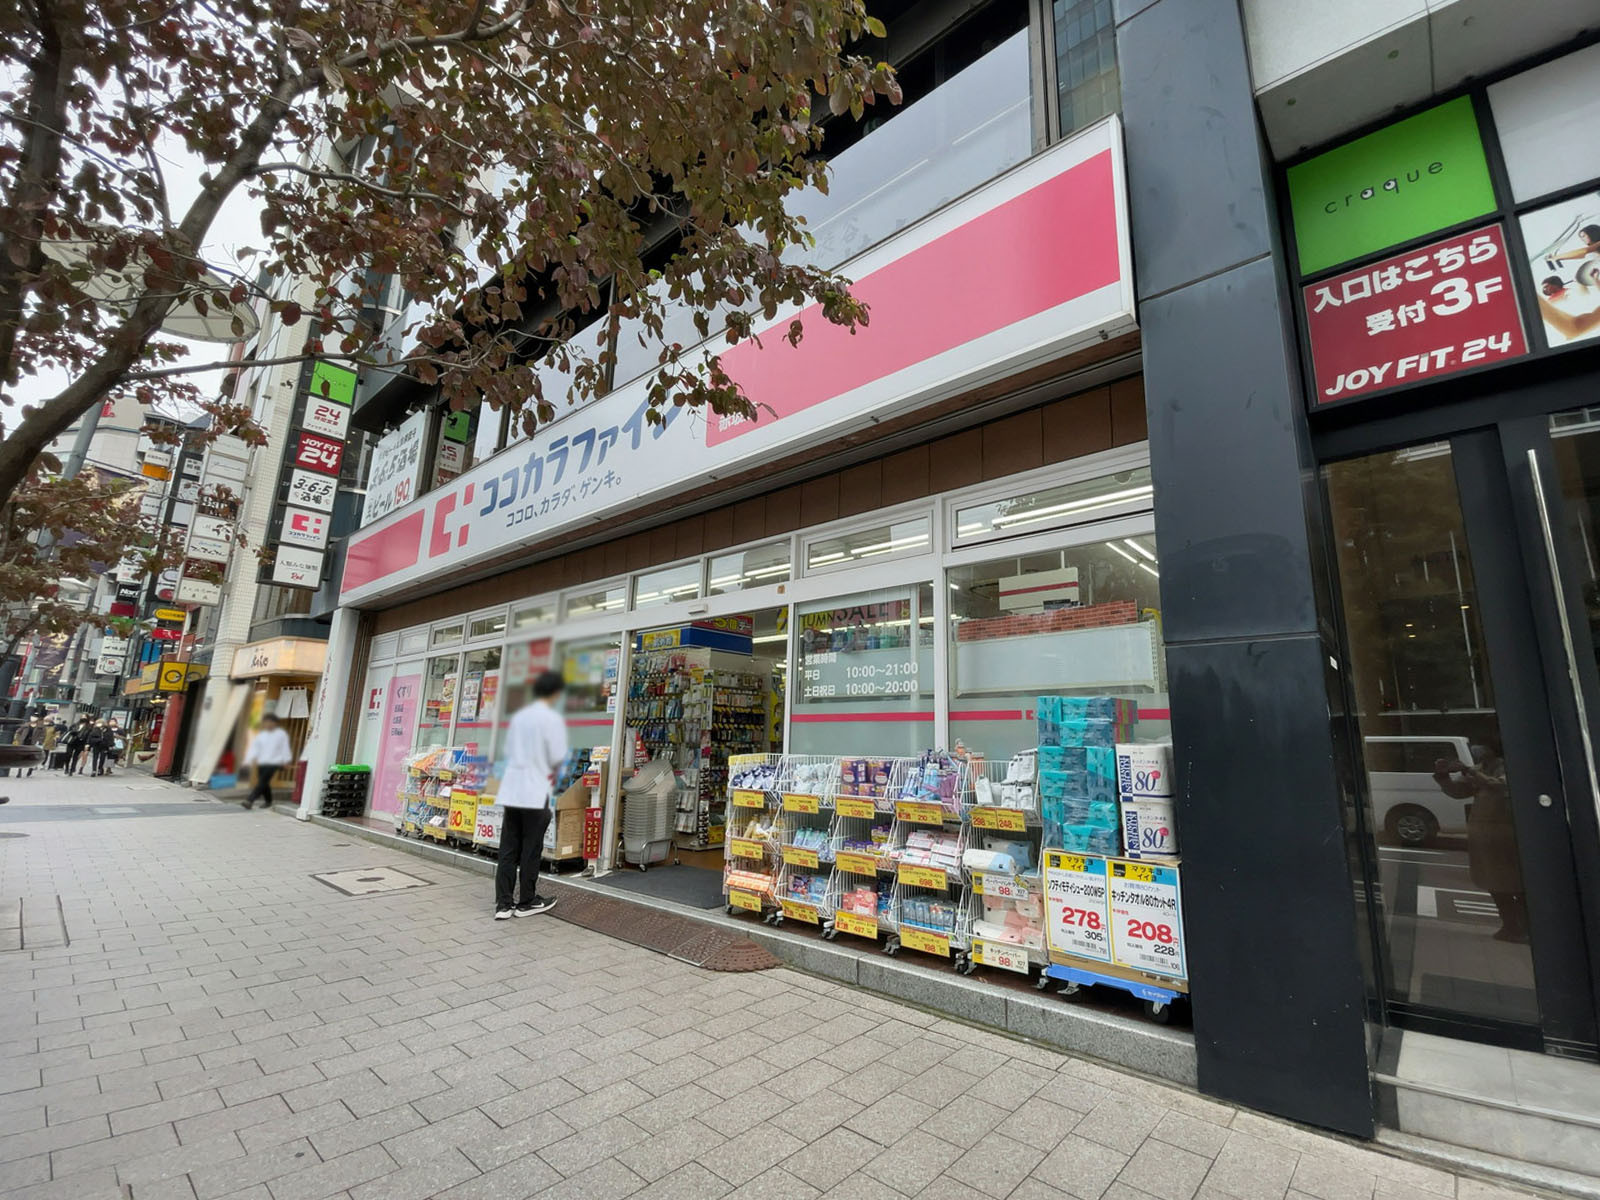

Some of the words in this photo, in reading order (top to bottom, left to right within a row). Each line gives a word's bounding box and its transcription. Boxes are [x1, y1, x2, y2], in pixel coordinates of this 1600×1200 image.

[1324, 160, 1443, 214] craque
[1313, 235, 1498, 313] 入口はこちら
[1366, 300, 1426, 336] 受付
[1430, 276, 1503, 317] 3F
[1325, 362, 1393, 396] JOY
[1461, 331, 1512, 363] 24
[314, 404, 341, 420] 24
[298, 446, 338, 468] 24
[505, 474, 622, 528] ココロ、カラダ、ゲンキ。
[804, 652, 838, 665] 営業時間
[804, 669, 821, 681] 平日
[804, 684, 836, 697] 土日祝日
[1134, 770, 1156, 792] 80
[477, 823, 494, 838] 798
[1142, 827, 1164, 849] 80
[1061, 906, 1101, 931] 278
[1127, 918, 1174, 944] 208
